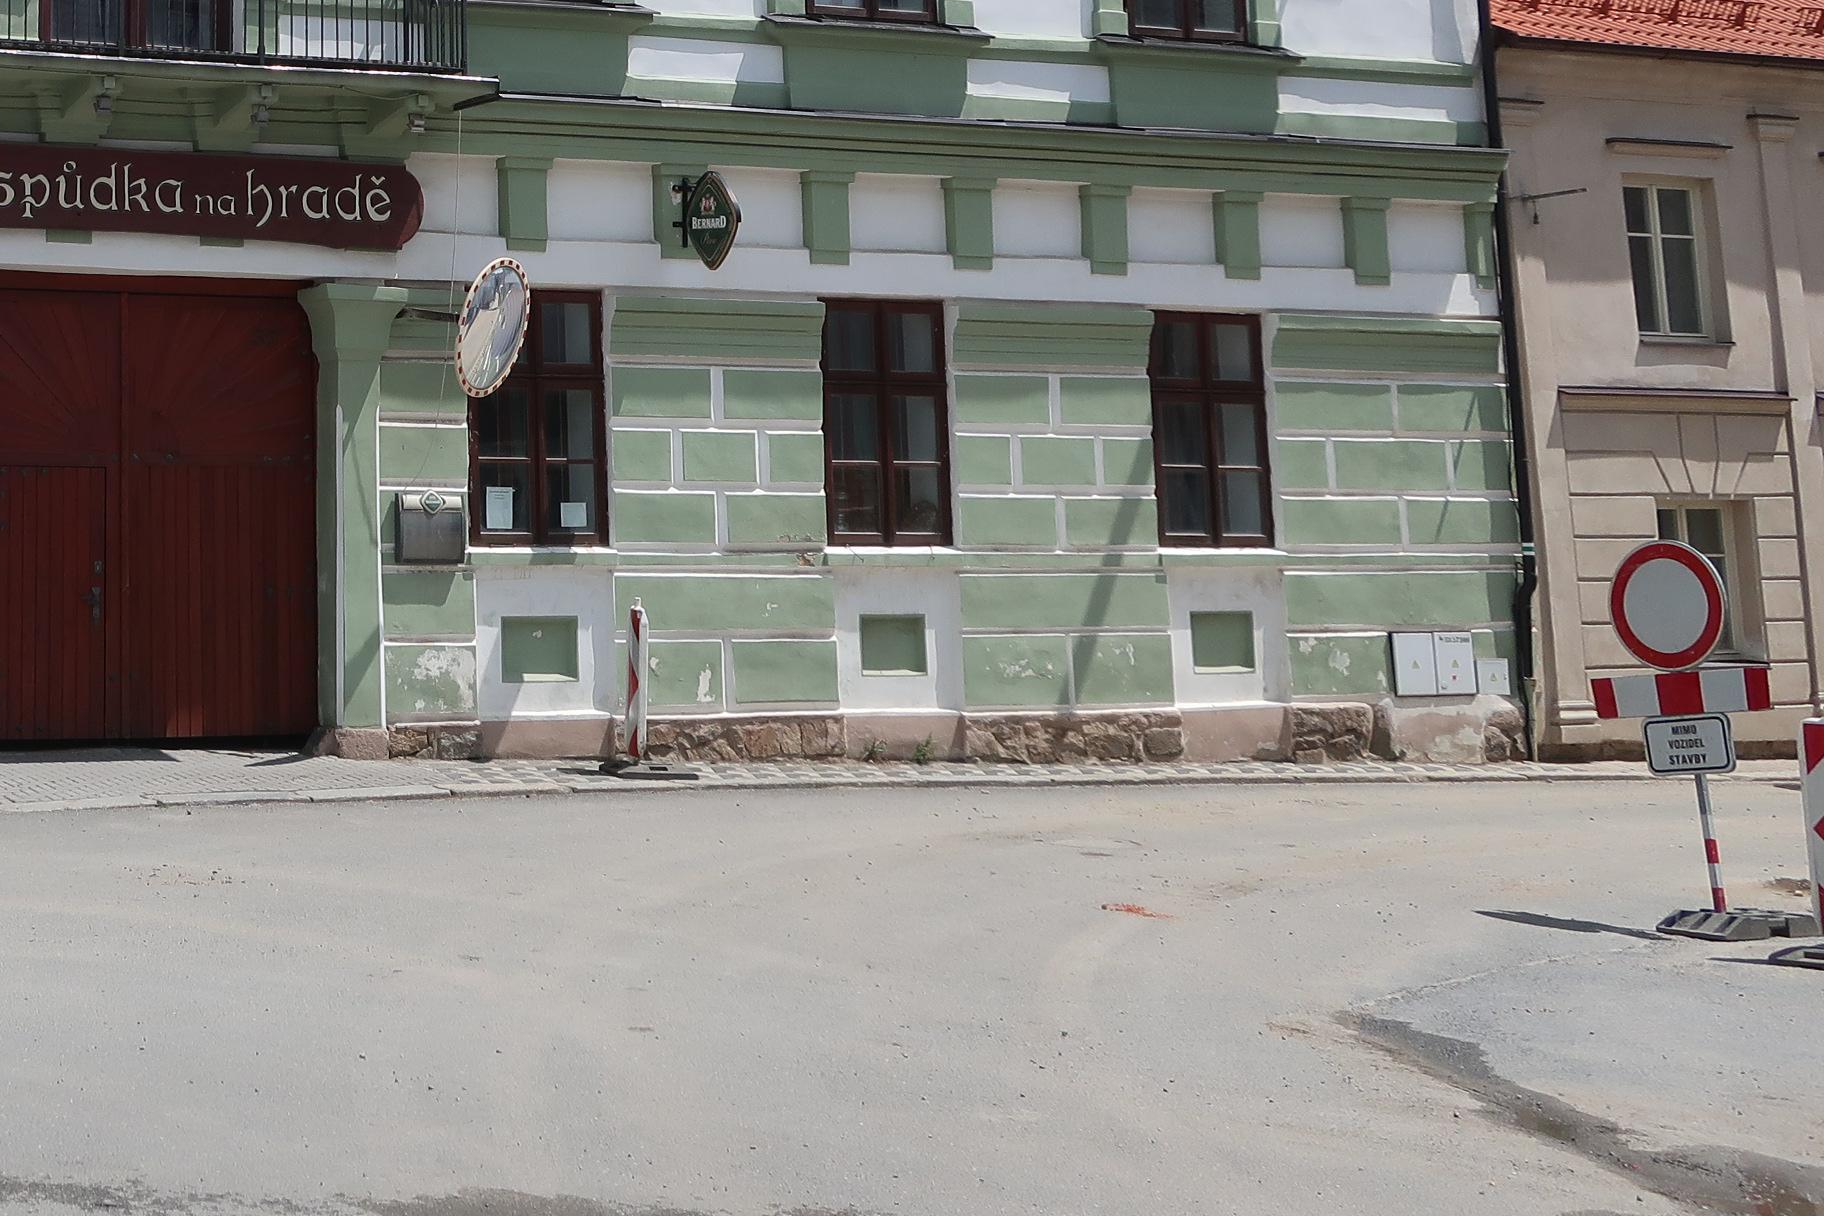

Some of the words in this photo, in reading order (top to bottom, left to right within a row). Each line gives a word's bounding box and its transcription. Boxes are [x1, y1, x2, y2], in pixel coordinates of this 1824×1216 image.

[194, 188, 236, 216] na
[245, 168, 393, 229] hradě
[691, 215, 727, 230] BERNARD
[1671, 724, 1697, 735] MIMO
[1667, 738, 1705, 749] VOZIDEL
[1669, 753, 1707, 765] STAVBY
